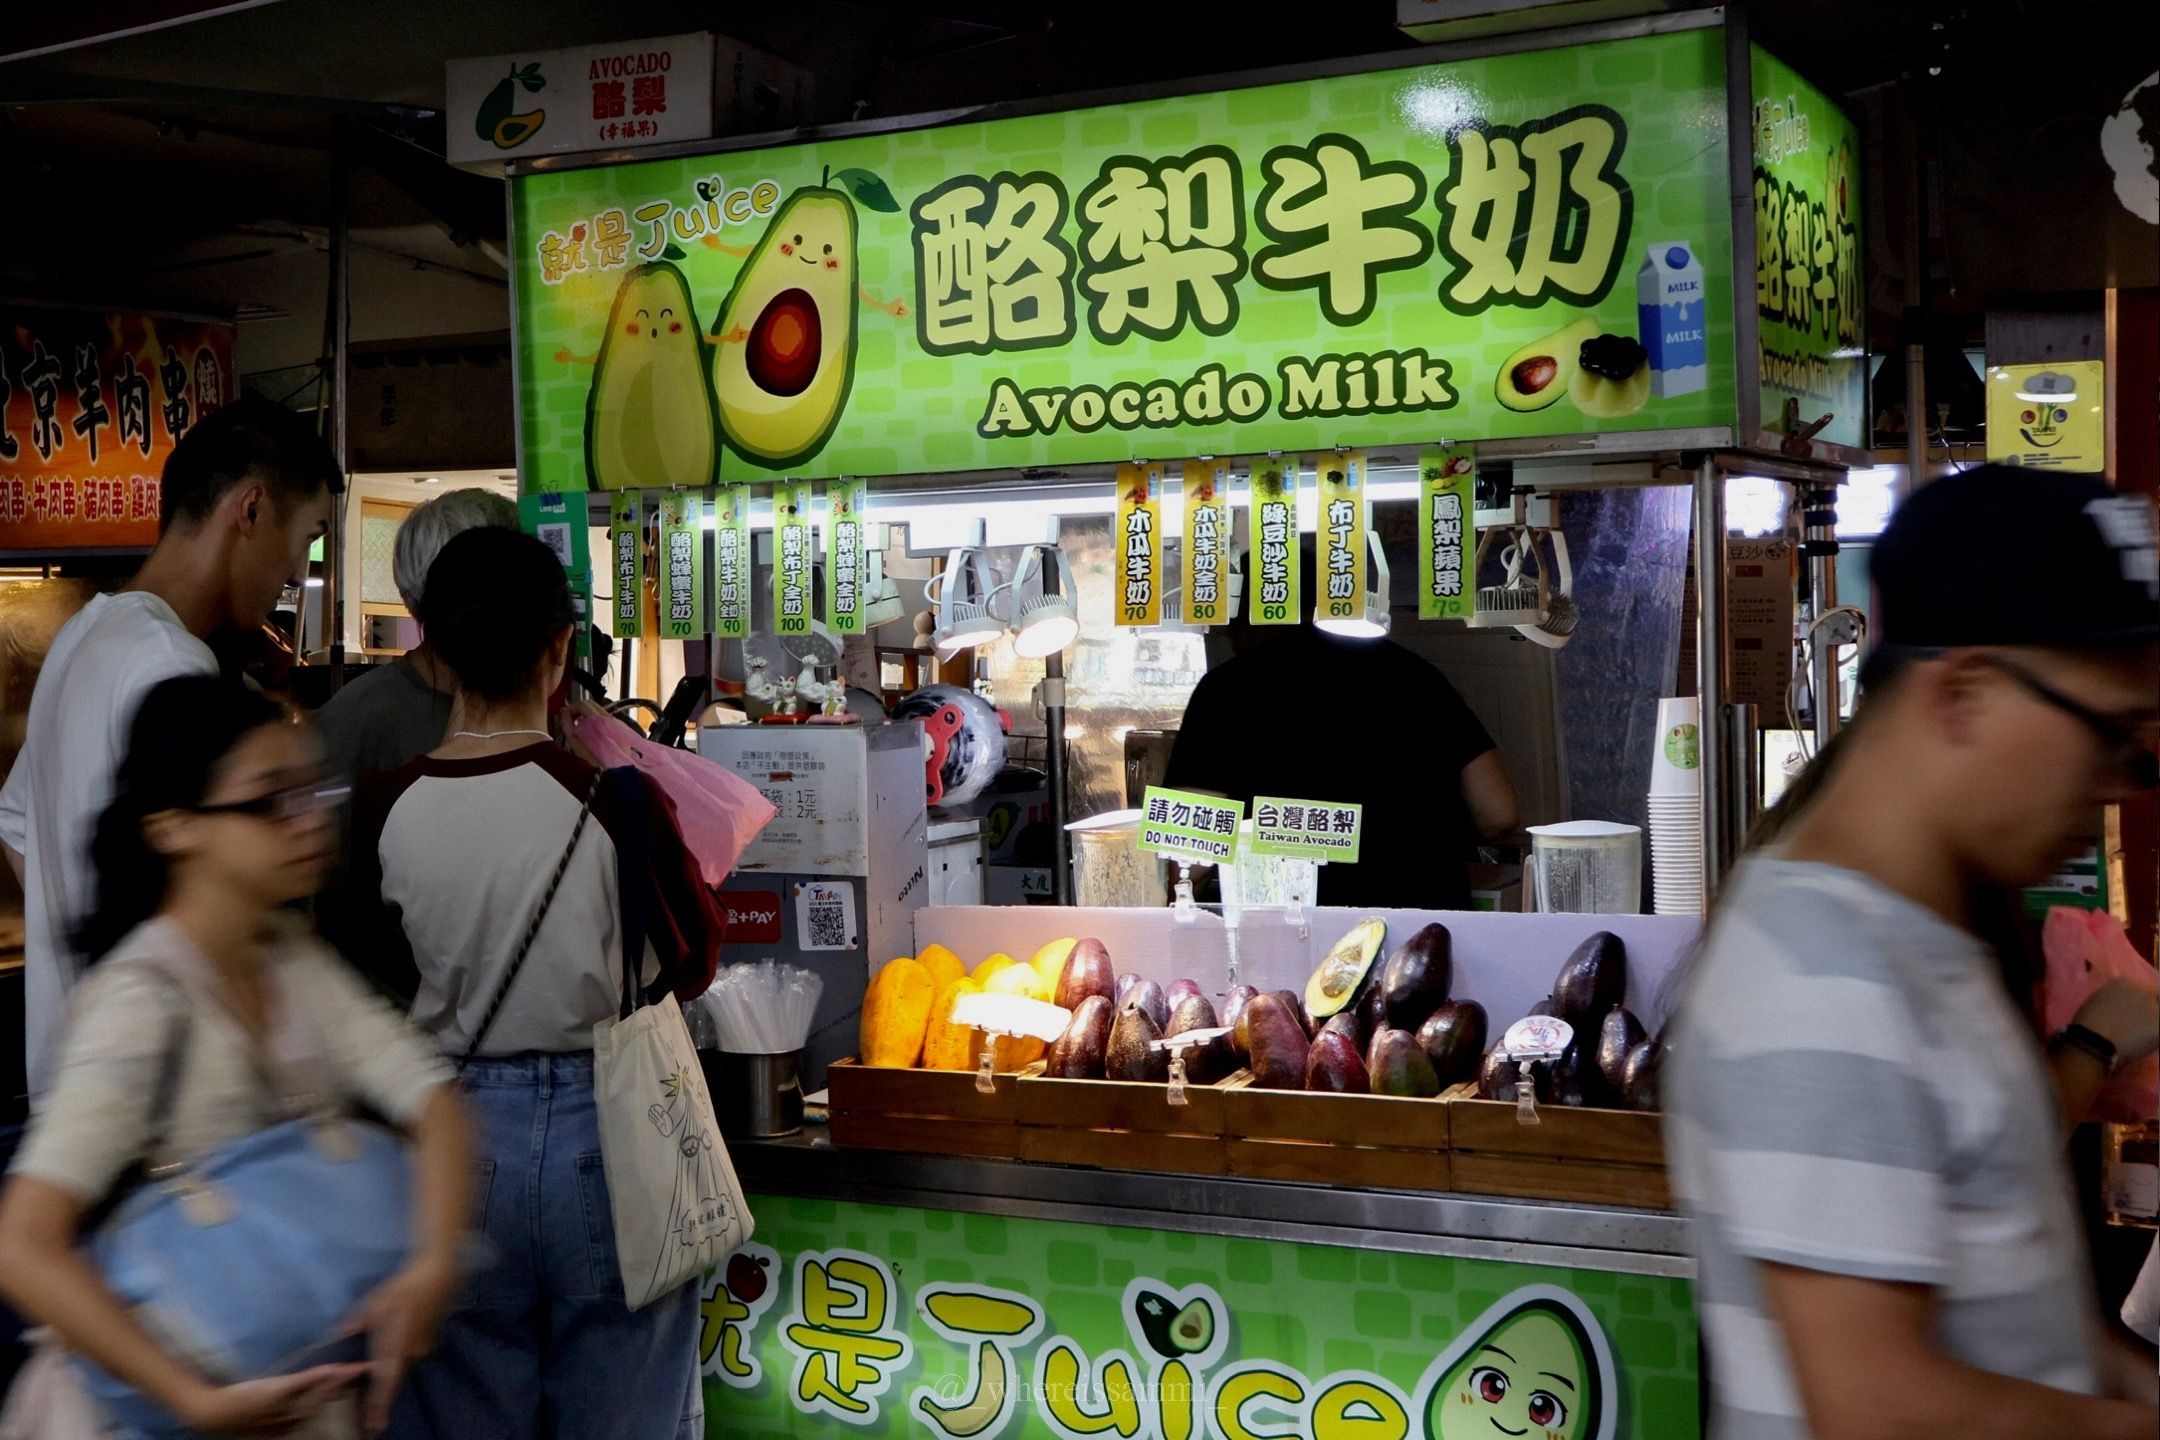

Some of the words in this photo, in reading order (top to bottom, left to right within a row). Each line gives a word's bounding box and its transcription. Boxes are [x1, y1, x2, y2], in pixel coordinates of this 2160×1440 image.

[588, 51, 672, 80] AVOCADO
[591, 74, 667, 120] 酪梨
[599, 120, 659, 141] (幸福果)
[911, 105, 1633, 356] 酪梨牛奶
[1668, 281, 1698, 293] MILK
[1666, 329, 1702, 343] MILK
[978, 362, 1268, 438] Avocado
[1281, 349, 1456, 418] Milk
[1125, 508, 1151, 605] 木瓜牛奶
[1193, 505, 1218, 603] 木瓜牛奶全奶
[1262, 502, 1288, 603] 綠豆沙牛奶
[1328, 499, 1354, 599] 布丁牛奶
[1432, 493, 1462, 596] 鳳梨蘋果
[618, 531, 636, 620] 酪梨布丁牛奶
[669, 531, 693, 620] 酪梨蜂蜜牛奶
[719, 528, 739, 602] 酪梨牛奶
[782, 525, 802, 615] 酪梨布丁全奶
[835, 521, 856, 614] 酪梨蜂蜜全奶
[836, 616, 854, 630] 90
[1124, 606, 1147, 620] 70
[1193, 605, 1216, 619] 80
[1263, 606, 1287, 620] 60
[1330, 602, 1353, 616] 60
[1433, 600, 1461, 617] 70
[620, 621, 635, 635] 70
[672, 622, 692, 635] 70
[725, 619, 741, 633] 90
[781, 618, 805, 632] 100
[1148, 797, 1236, 836] 請勿碰觸
[1257, 804, 1355, 834] 台灣酪梨
[1145, 830, 1161, 844] DO
[1164, 834, 1187, 848] NOT
[1190, 838, 1230, 857] TOUCH
[1258, 831, 1300, 844] Taiwan
[1303, 835, 1352, 848] Avocado
